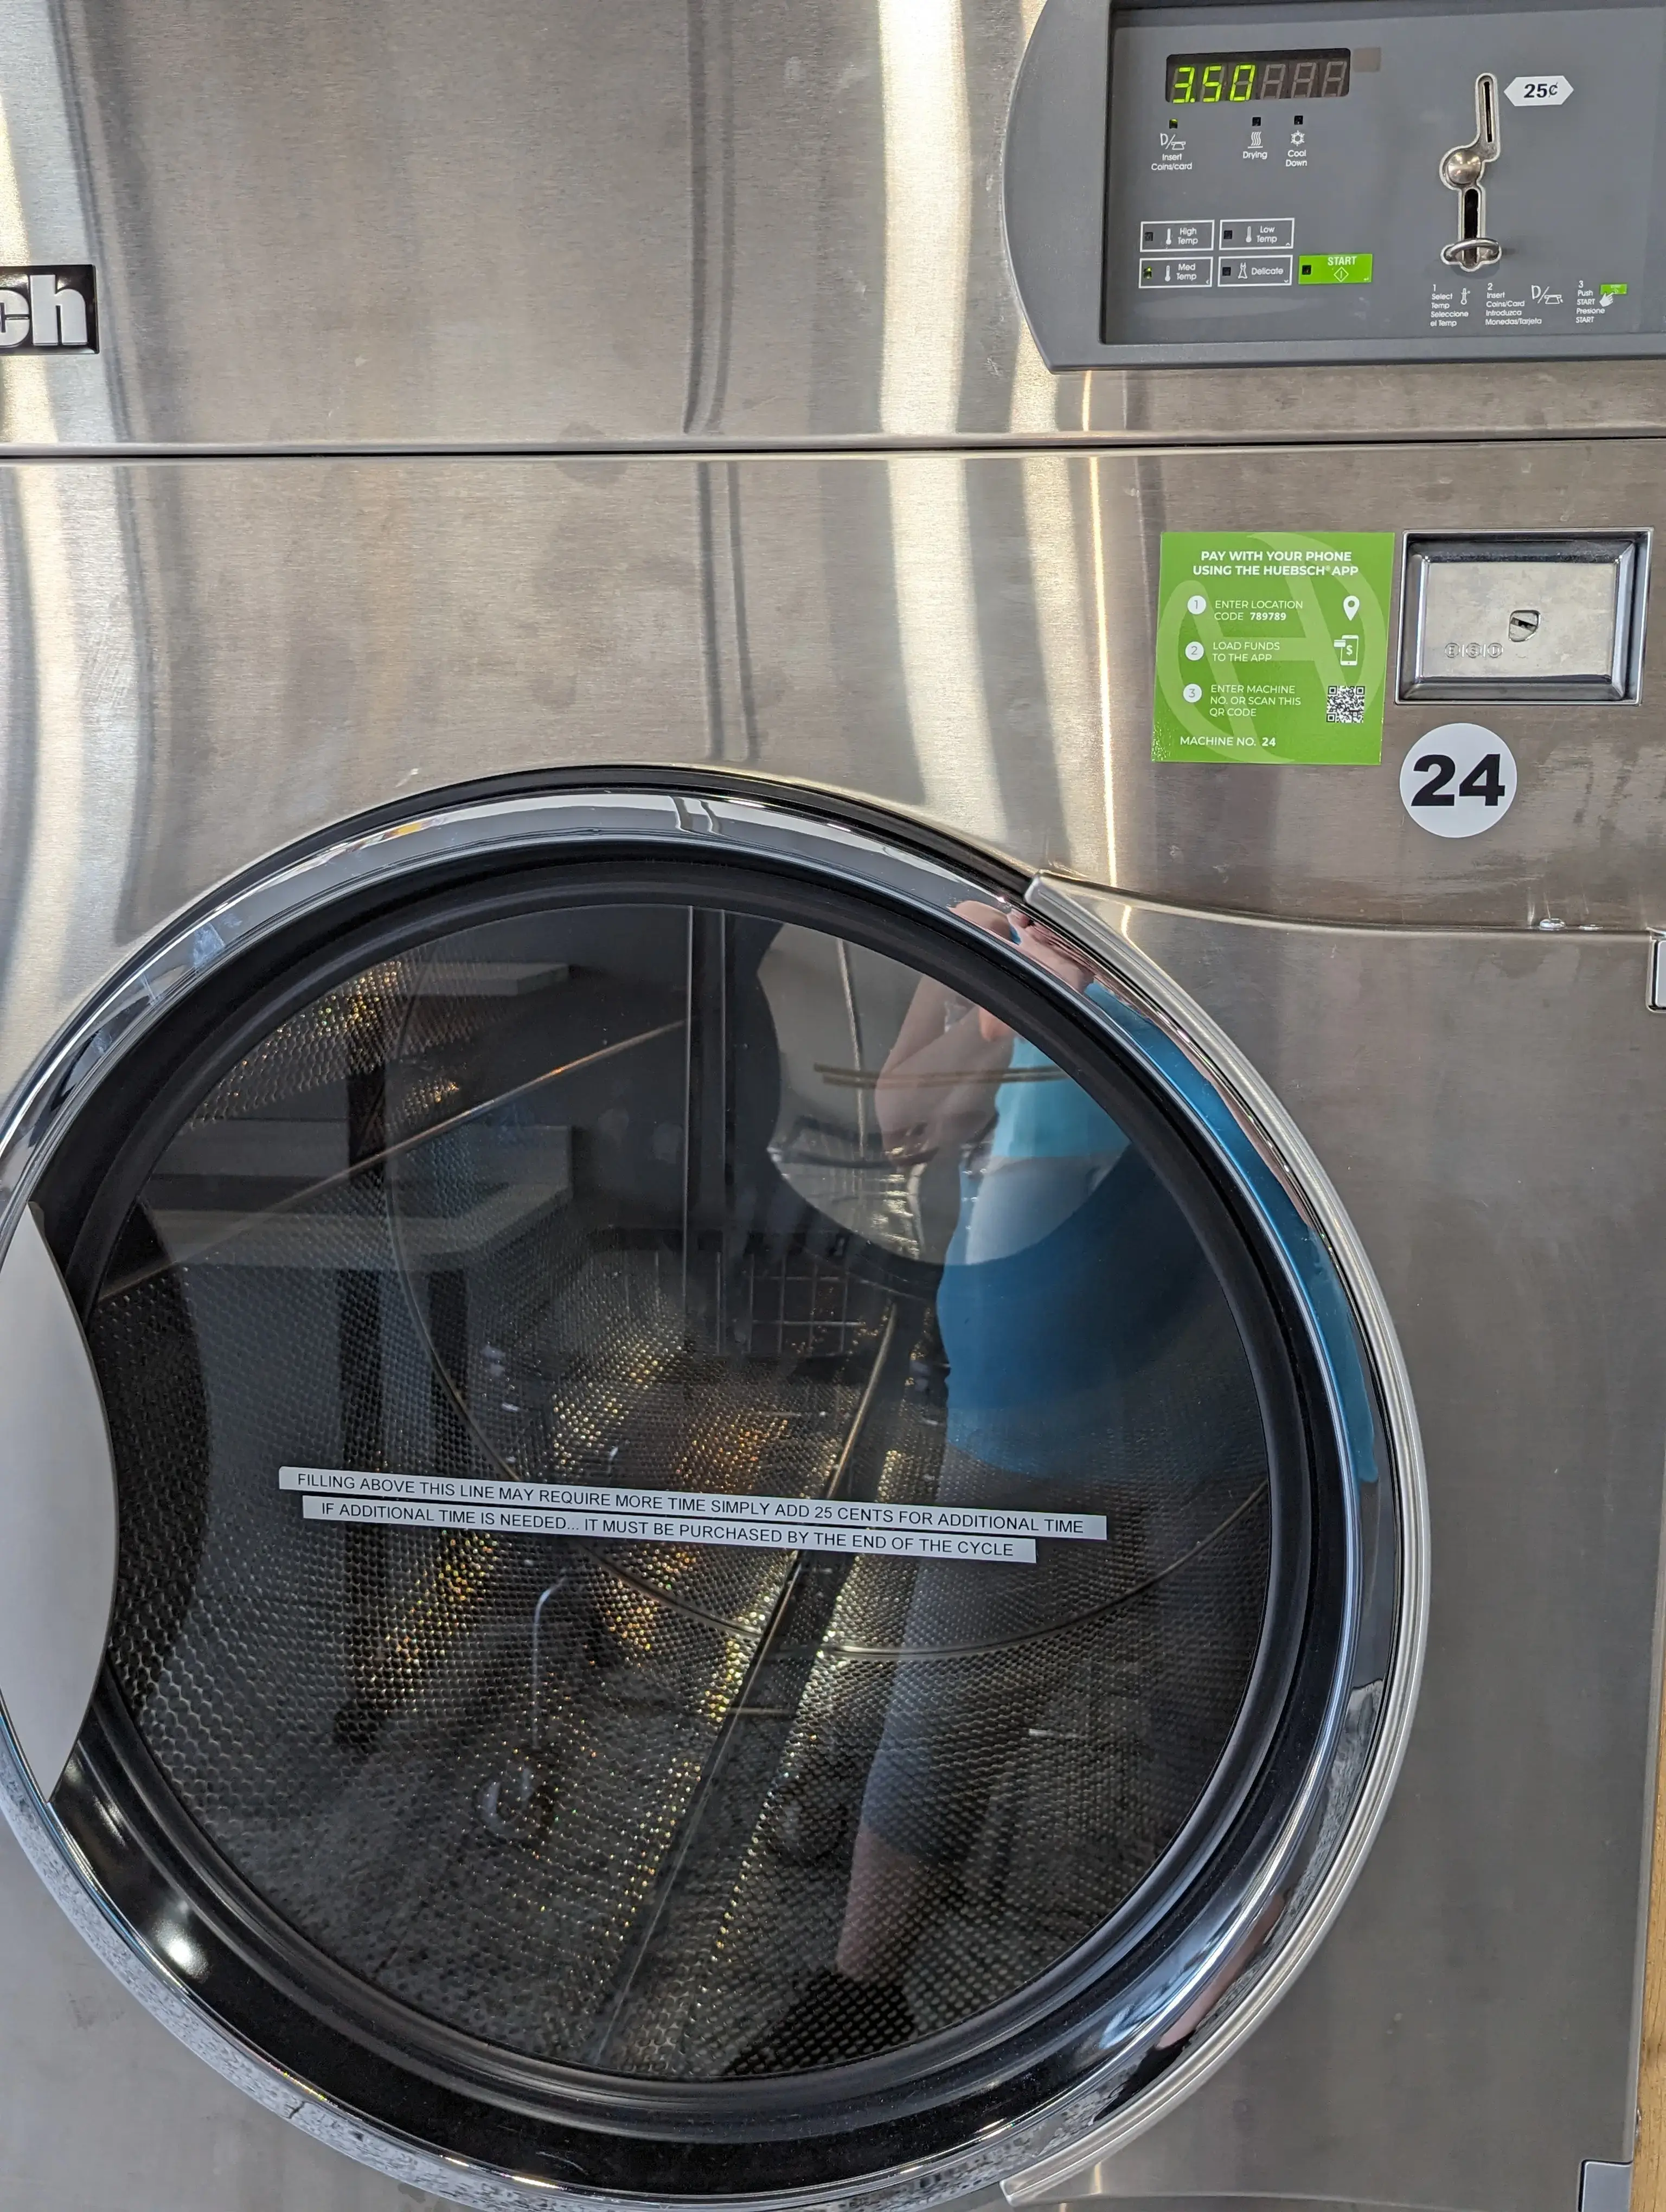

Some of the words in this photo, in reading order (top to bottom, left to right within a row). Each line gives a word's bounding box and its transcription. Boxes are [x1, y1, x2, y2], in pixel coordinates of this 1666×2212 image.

[1172, 63, 1257, 104] 3.50
[1523, 82, 1558, 98] 25¢
[1162, 153, 1182, 161] Insert
[1242, 151, 1268, 160] Drying
[1151, 162, 1193, 171] Coins/card
[1180, 227, 1197, 237] High
[1260, 226, 1275, 234] Low
[1178, 237, 1199, 246] Temp
[1257, 234, 1277, 244] Temp
[1327, 256, 1357, 266] START
[1178, 263, 1196, 271] Med
[1251, 267, 1284, 275] Delicate
[1176, 272, 1197, 281] Temp
[1488, 282, 1493, 291] 2
[1578, 280, 1584, 288] 3
[1439, 319, 1457, 327] Temp
[1485, 318, 1542, 326] Monedas/Tarjeta
[1201, 551, 1226, 561] PAY
[1229, 551, 1263, 561] WITH
[1266, 551, 1302, 562] YOUR
[1305, 551, 1352, 562] PHONE
[1193, 565, 1233, 575] USING
[1235, 565, 1260, 575] THE
[1331, 566, 1359, 576] APP
[1194, 600, 1199, 609] 1
[1215, 601, 1248, 609] ENTER
[1252, 601, 1303, 609] LOCATION
[1215, 613, 1244, 621] CODE
[1250, 613, 1286, 621] 789789
[1191, 647, 1198, 655] 2
[1213, 642, 1242, 650] LOAD
[1244, 642, 1280, 651] FUNDS
[1213, 654, 1226, 662] TO
[1229, 654, 1248, 662] THE
[1251, 654, 1272, 662] APP
[1189, 689, 1195, 698] 3
[1211, 685, 1244, 693] ENTER
[1247, 685, 1295, 694] MACHINE
[1210, 697, 1228, 705] NO.
[1231, 697, 1246, 705] OR
[1248, 697, 1276, 705] SCAN
[1279, 697, 1301, 706] THIS
[1210, 709, 1225, 717] QR
[1227, 709, 1257, 717] CODE
[1180, 737, 1233, 746] MACHINE
[1237, 737, 1256, 747] NO.
[1262, 737, 1276, 747] 24
[1411, 754, 1505, 806] 24
[298, 1474, 355, 1489] FILLING
[360, 1477, 415, 1494] ABOVE
[420, 1482, 455, 1496] THIS
[460, 1484, 494, 1499] LINE
[499, 1488, 534, 1502] MAY
[540, 1490, 611, 1506] REQUIRE
[616, 1495, 663, 1509] MORE
[668, 1497, 706, 1512] TIME
[711, 1500, 770, 1515] SIMPLY
[775, 1504, 810, 1517] ADD
[814, 1506, 832, 1519] 25
[838, 1507, 893, 1522] CENTS
[899, 1510, 933, 1525] FOR
[938, 1513, 1039, 1531] ADDITIONAL
[1044, 1519, 1084, 1533] TIME
[322, 1502, 335, 1515] IF
[339, 1503, 434, 1521] ADDITIONAL
[439, 1509, 476, 1523] TIME
[480, 1513, 495, 1525] IS
[500, 1514, 579, 1531] NEEDED...
[585, 1519, 598, 1531] IT
[603, 1520, 648, 1535] MUST
[653, 1523, 675, 1535] BE
[680, 1525, 782, 1542] PURCHASED
[787, 1531, 810, 1543] BY
[813, 1532, 847, 1546] THE
[853, 1535, 886, 1548] END
[892, 1536, 914, 1549] OF
[919, 1538, 952, 1552] THE
[957, 1541, 1014, 1556] CYCLE
